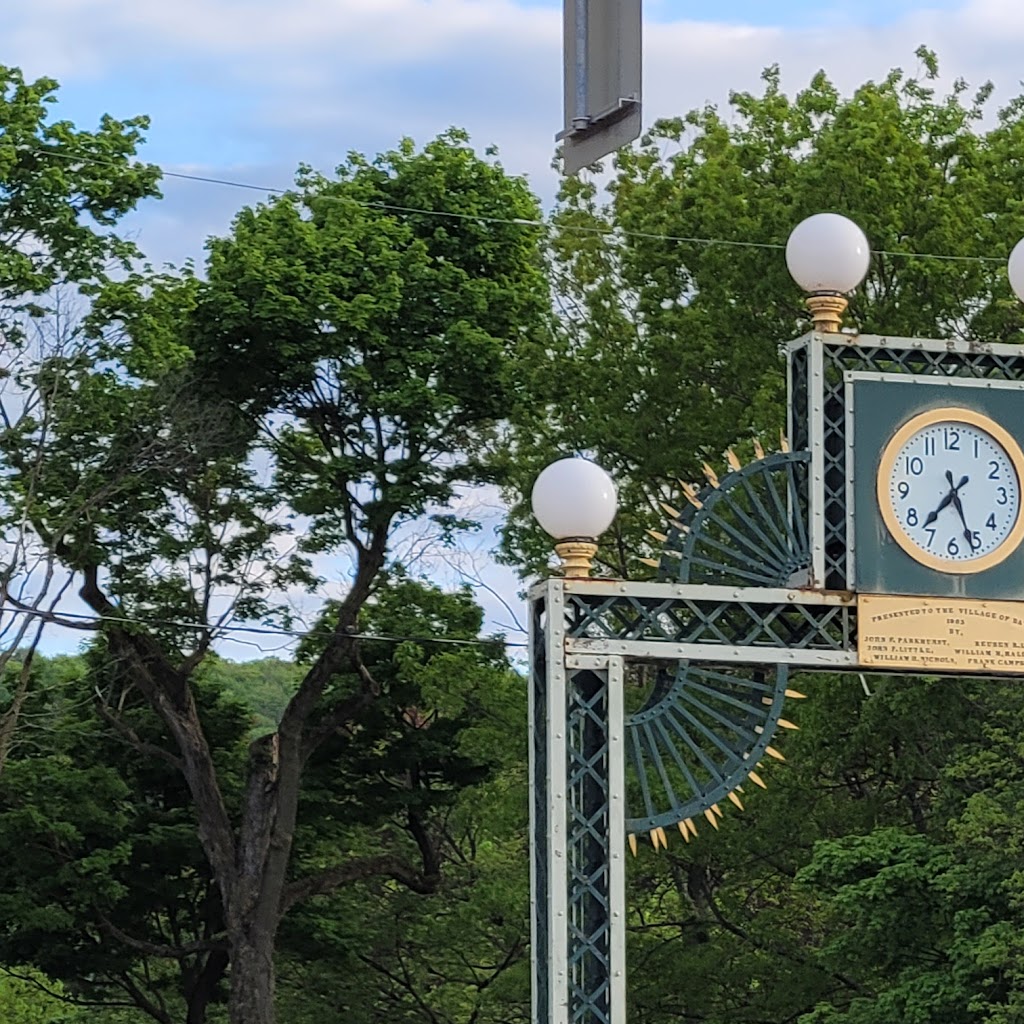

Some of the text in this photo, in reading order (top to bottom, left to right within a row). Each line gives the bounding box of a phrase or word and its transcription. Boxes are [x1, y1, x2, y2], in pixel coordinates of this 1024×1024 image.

[924, 437, 935, 456] 11
[944, 429, 960, 451] 12
[973, 439, 979, 459] 1
[905, 456, 924, 476] 10
[988, 461, 1000, 480] 2
[897, 481, 910, 500] 9
[996, 487, 1008, 506] 3
[906, 508, 918, 527] 8
[986, 512, 997, 531] 4
[924, 529, 936, 547] 7
[947, 537, 959, 556] 6
[971, 531, 982, 550] 5
[871, 608, 920, 623] PRESENTED
[921, 607, 934, 615] TO
[958, 608, 998, 619] VILLAGE
[998, 613, 1010, 622] OF
[975, 640, 1009, 648] REUBEN
[873, 654, 910, 662] WILLIAM
